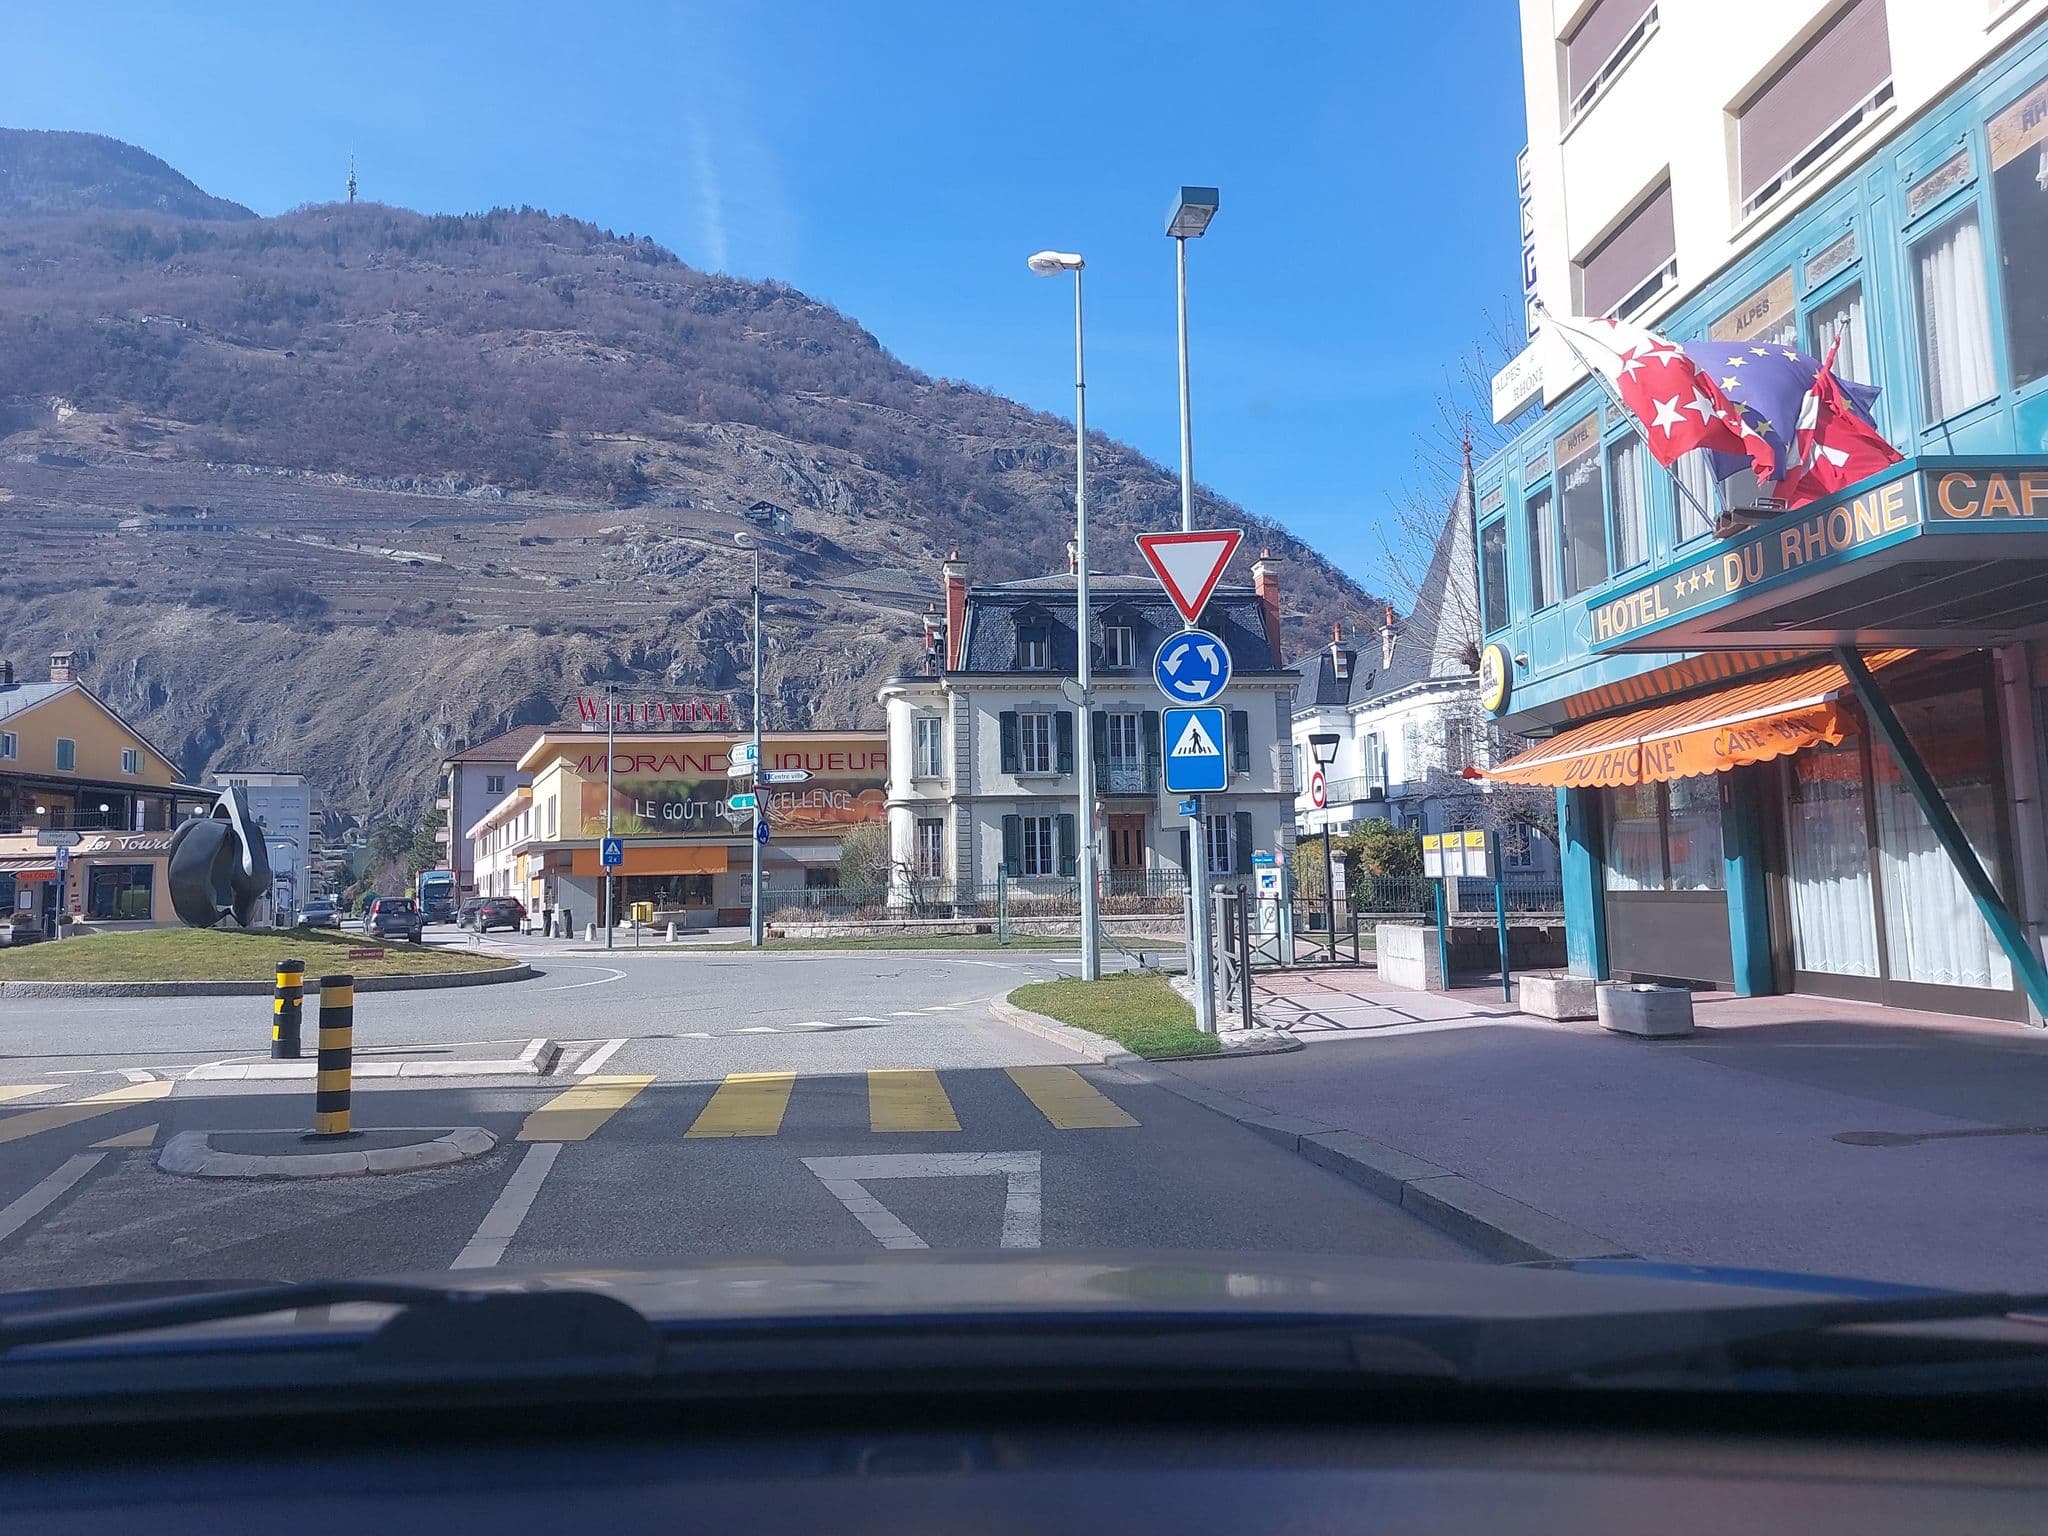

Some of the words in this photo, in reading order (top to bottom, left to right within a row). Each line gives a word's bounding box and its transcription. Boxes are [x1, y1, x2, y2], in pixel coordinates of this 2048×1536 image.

[1736, 298, 1769, 334] ALPES
[1494, 363, 1521, 395] ALPES
[1598, 586, 1670, 641] HOTEL
[1723, 544, 1765, 593] DU
[1780, 481, 1908, 571] RHONE
[574, 754, 729, 775] MORAND
[771, 772, 790, 780] Centre
[635, 799, 656, 819] LE
[662, 798, 708, 820] GOÛT
[86, 835, 112, 851] Les
